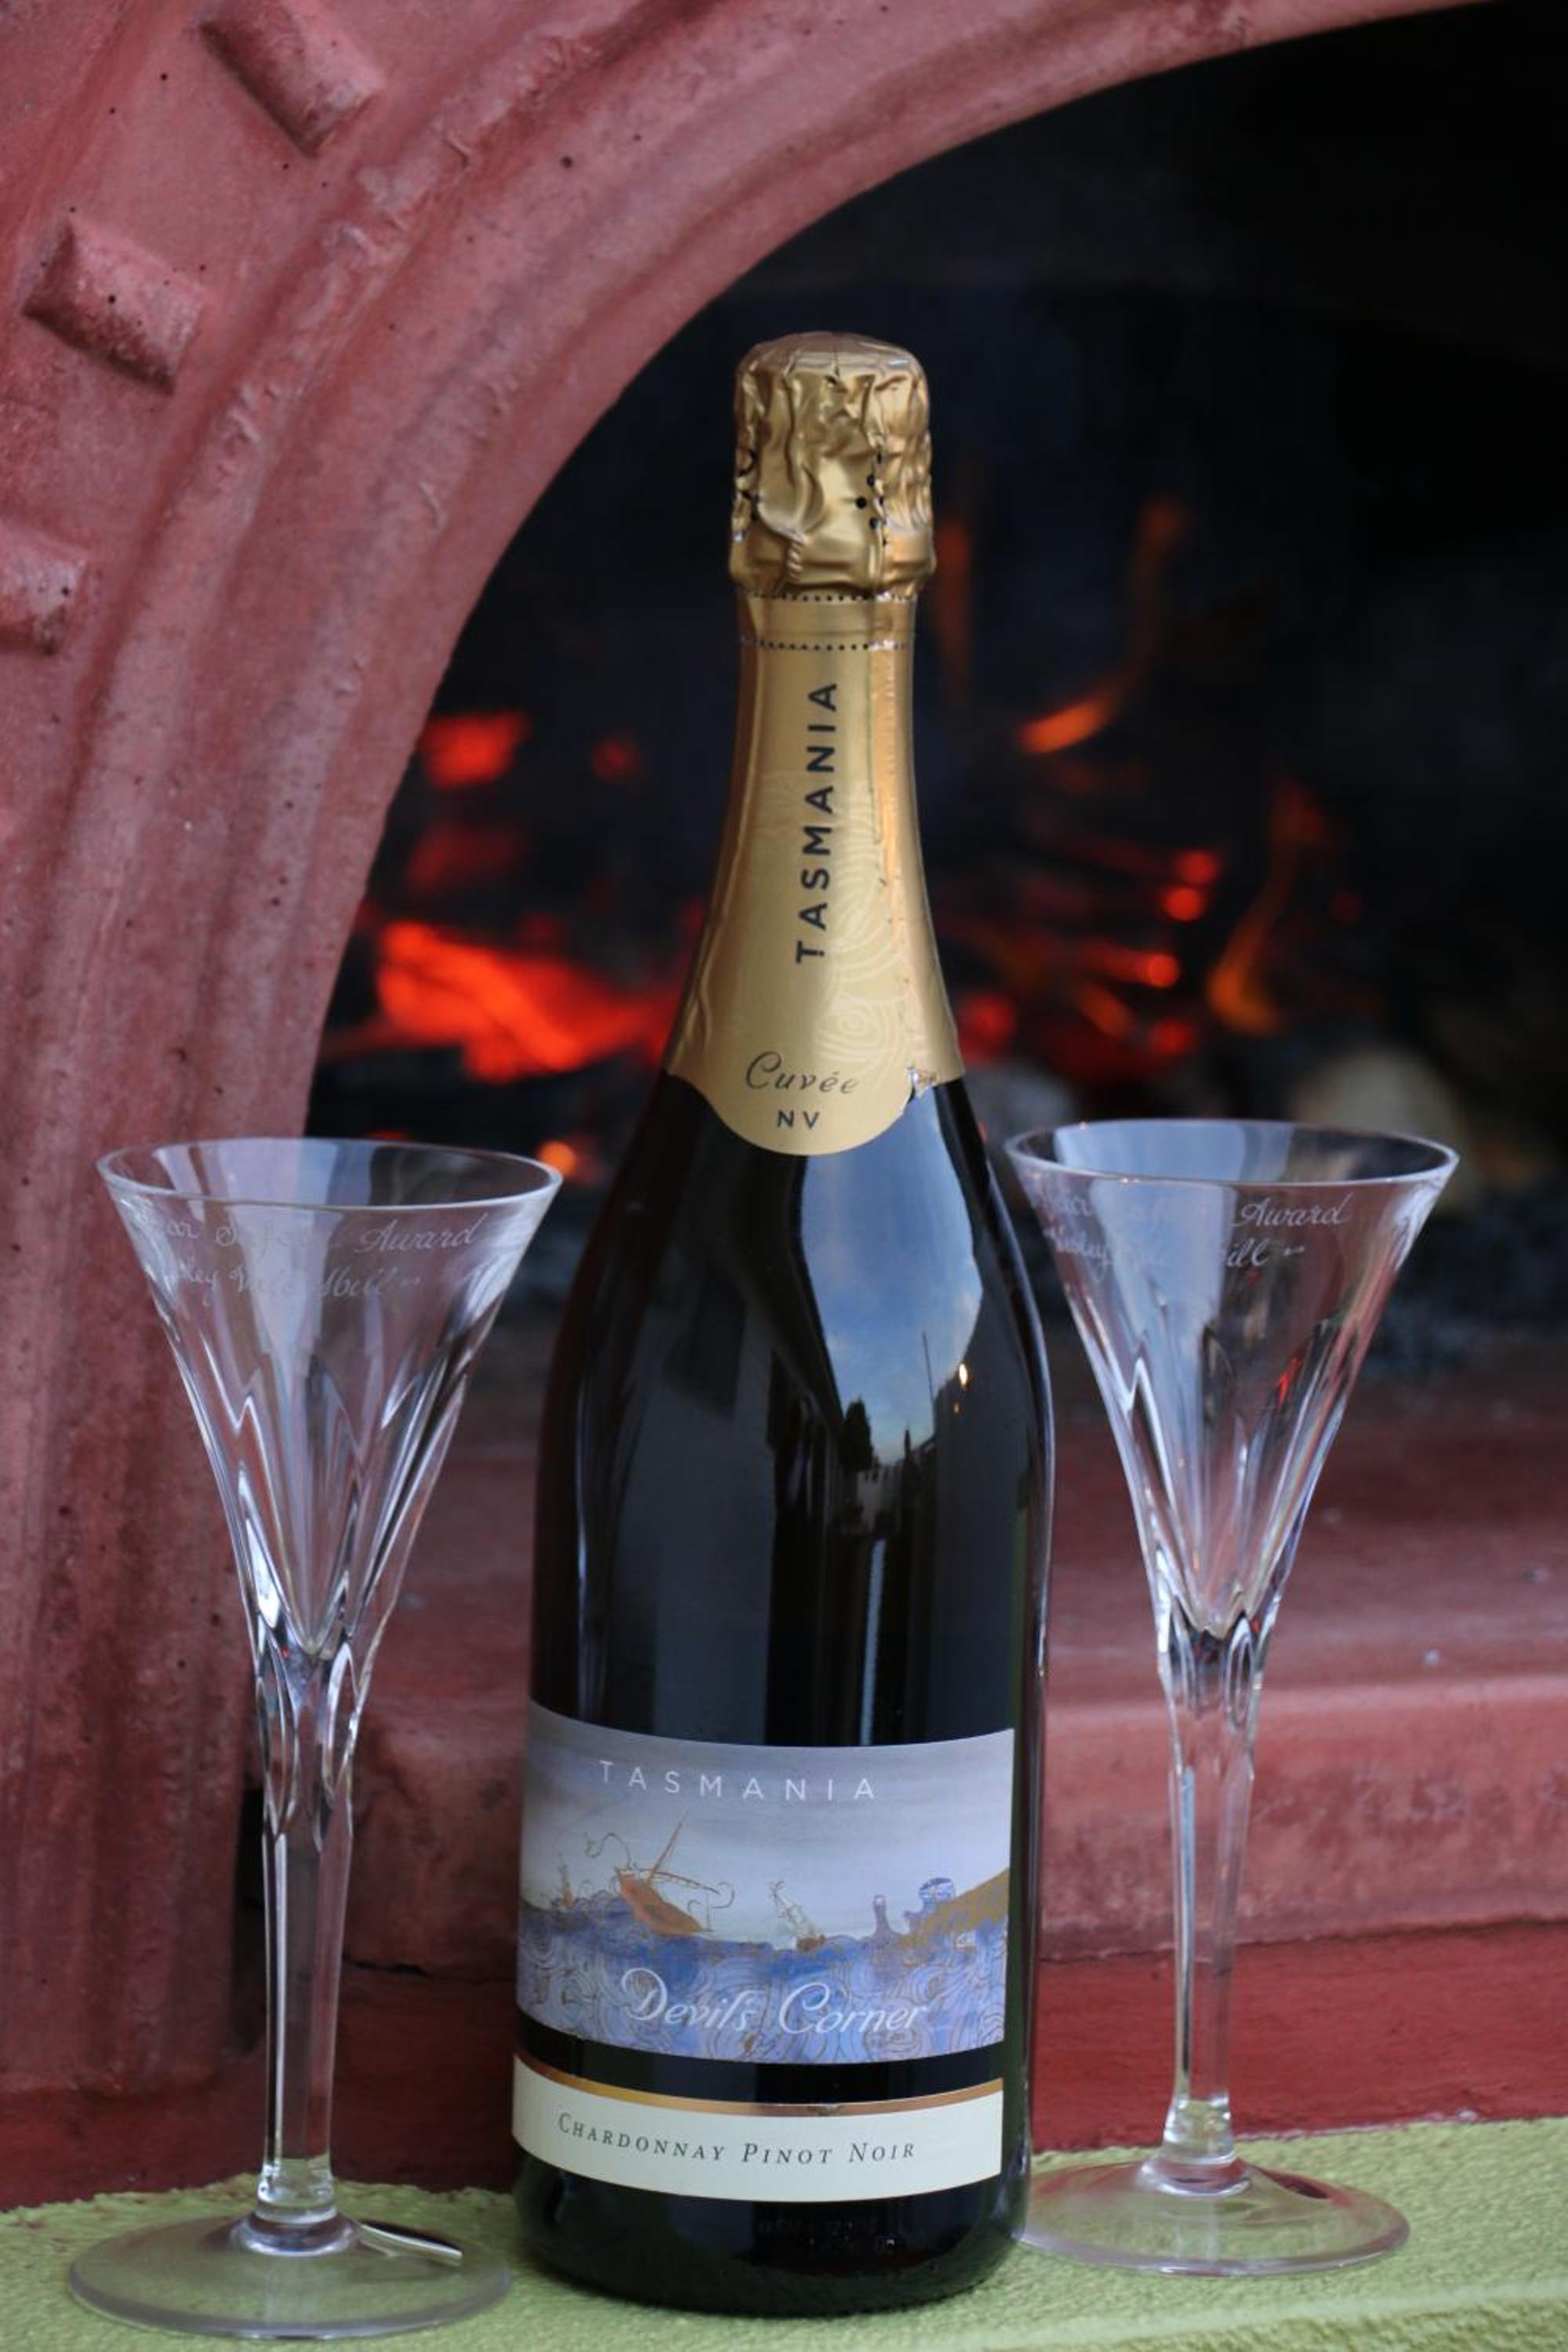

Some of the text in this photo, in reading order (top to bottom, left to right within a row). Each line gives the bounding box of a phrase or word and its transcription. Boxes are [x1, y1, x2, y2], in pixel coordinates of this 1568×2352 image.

[796, 683, 838, 964] TASMANIA
[745, 1051, 859, 1094] Cuvée
[1230, 1192, 1355, 1228] Award
[353, 1213, 488, 1254] Award
[599, 1760, 876, 1802] TASMANIA
[779, 1981, 928, 2034] Corner
[557, 2112, 915, 2165] CHARDONNAY PINOT NOIR
